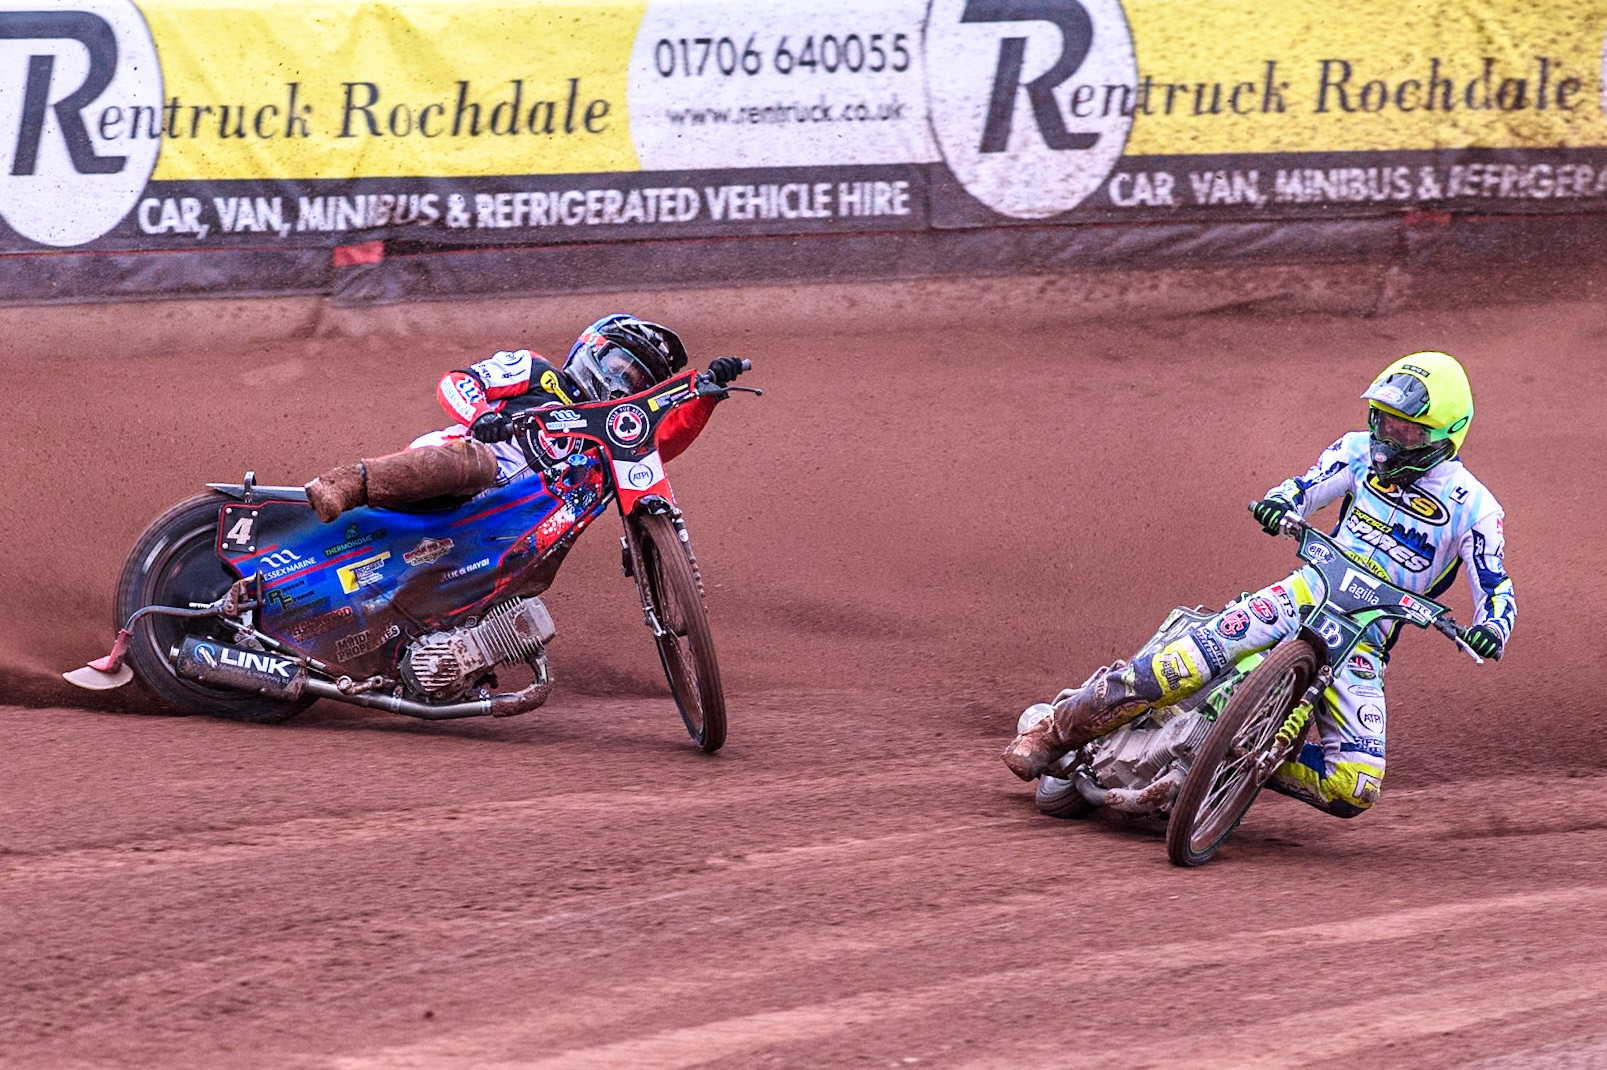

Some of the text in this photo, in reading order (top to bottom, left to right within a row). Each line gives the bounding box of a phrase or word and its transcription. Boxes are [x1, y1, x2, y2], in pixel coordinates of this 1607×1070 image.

[655, 34, 911, 78] 01706 640055
[0, 10, 611, 176] Rentruck Rochdale
[960, 0, 1583, 154] Rentruck Rochdale
[666, 94, 907, 125] www.rentruck.co.uk
[1275, 166, 1412, 203] MINIBUS
[1417, 165, 1442, 200] &
[138, 181, 911, 239] CAR, VAN, MINIBUS & REFRIGERATED VEHICLE HIRE
[1455, 486, 1469, 500] 4
[226, 517, 254, 545] 4
[1347, 514, 1432, 571] SPIRES
[1347, 582, 1381, 606] agilia
[220, 648, 293, 678] LINK
